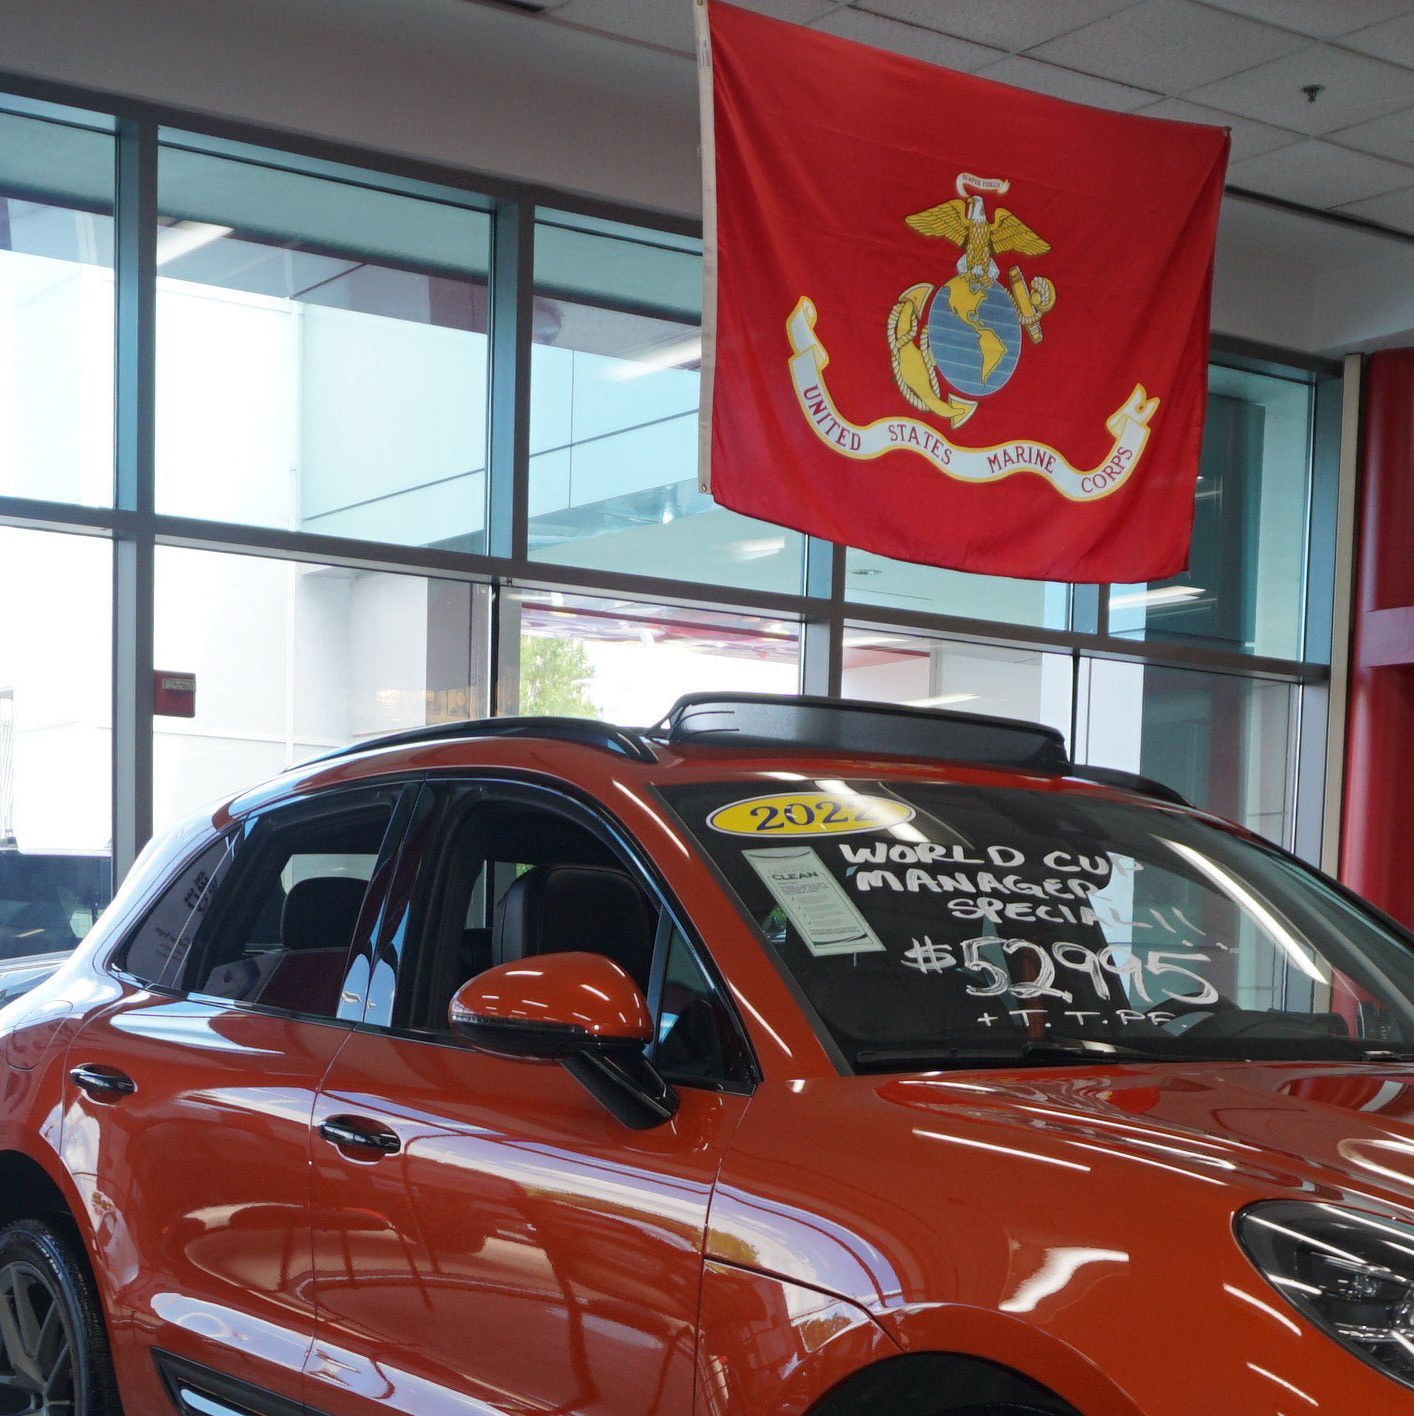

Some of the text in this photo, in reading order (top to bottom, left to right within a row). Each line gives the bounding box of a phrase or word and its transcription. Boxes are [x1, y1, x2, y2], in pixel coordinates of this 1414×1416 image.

[803, 384, 1133, 494] UNITED STATES MARINE CORPS
[750, 800, 878, 831] 2022
[772, 871, 819, 881] CLEAN
[838, 842, 1144, 877] WORLD CUP
[856, 868, 1113, 901] MANAGER
[900, 935, 1219, 1004] $52995
